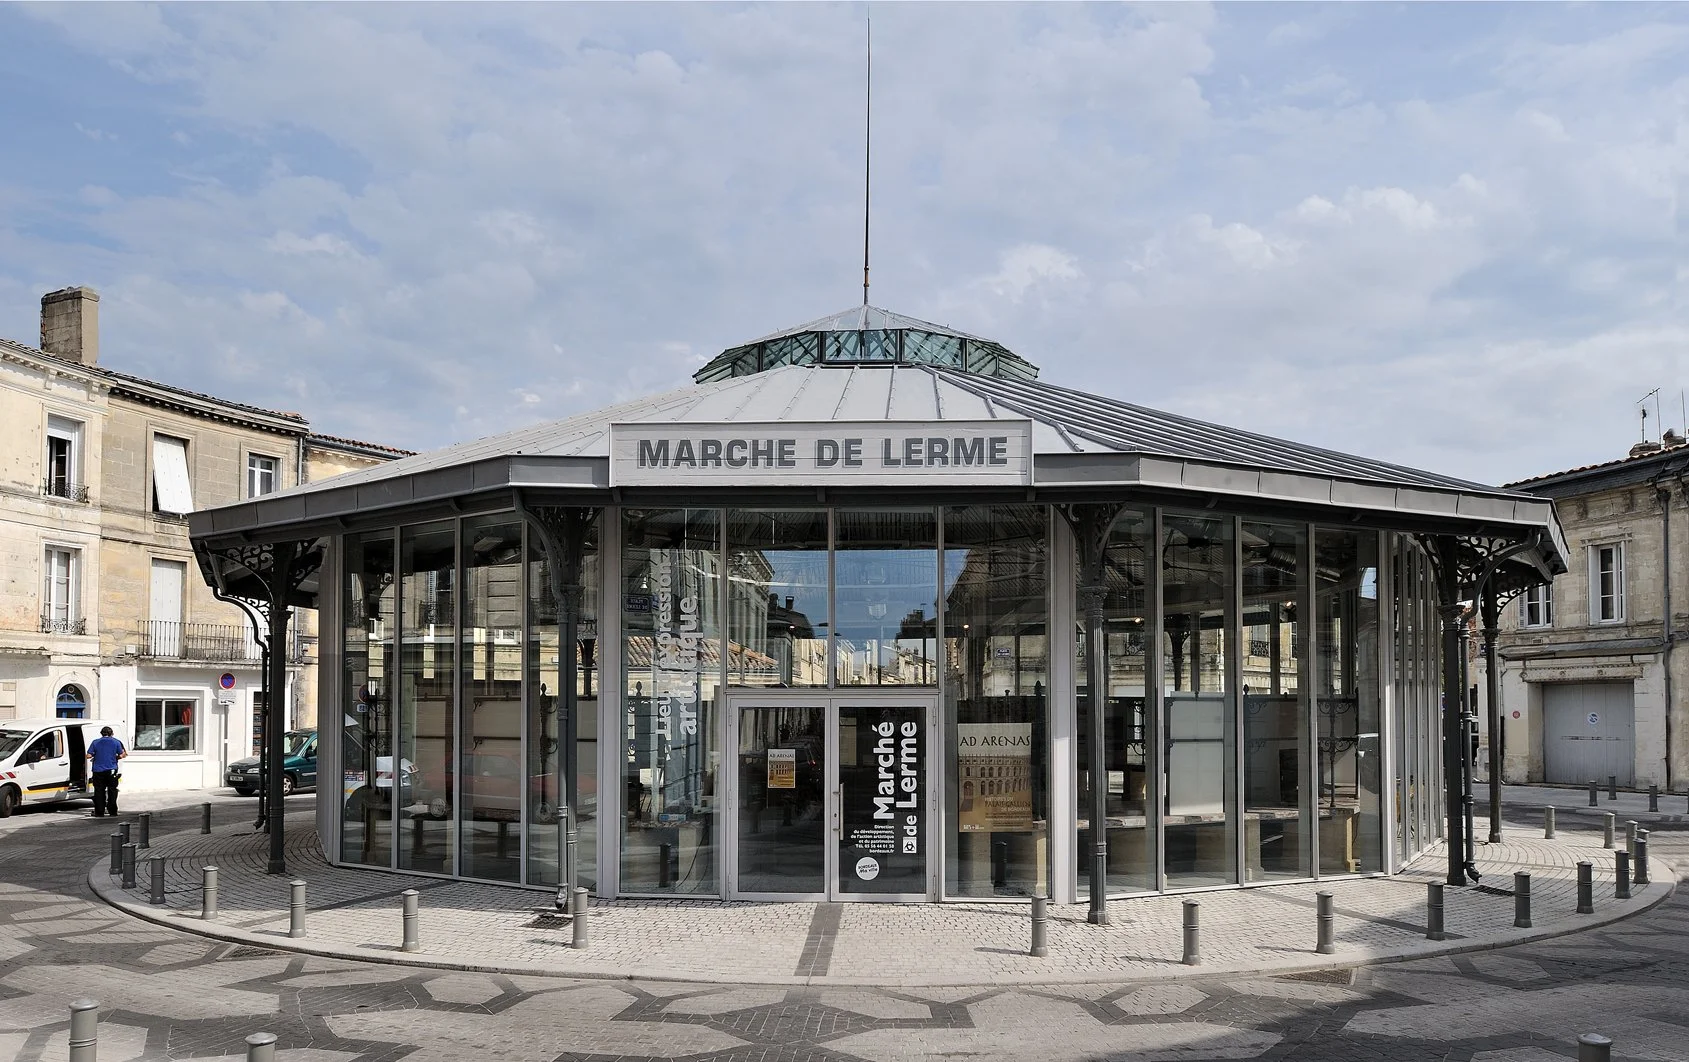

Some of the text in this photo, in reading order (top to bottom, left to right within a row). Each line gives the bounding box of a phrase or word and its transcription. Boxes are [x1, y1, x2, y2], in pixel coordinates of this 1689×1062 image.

[636, 436, 1009, 469] MARCHE DE LERME
[871, 721, 895, 820] Marché
[960, 735, 1031, 747] AD ARENAS
[896, 721, 917, 836] de Lerme
